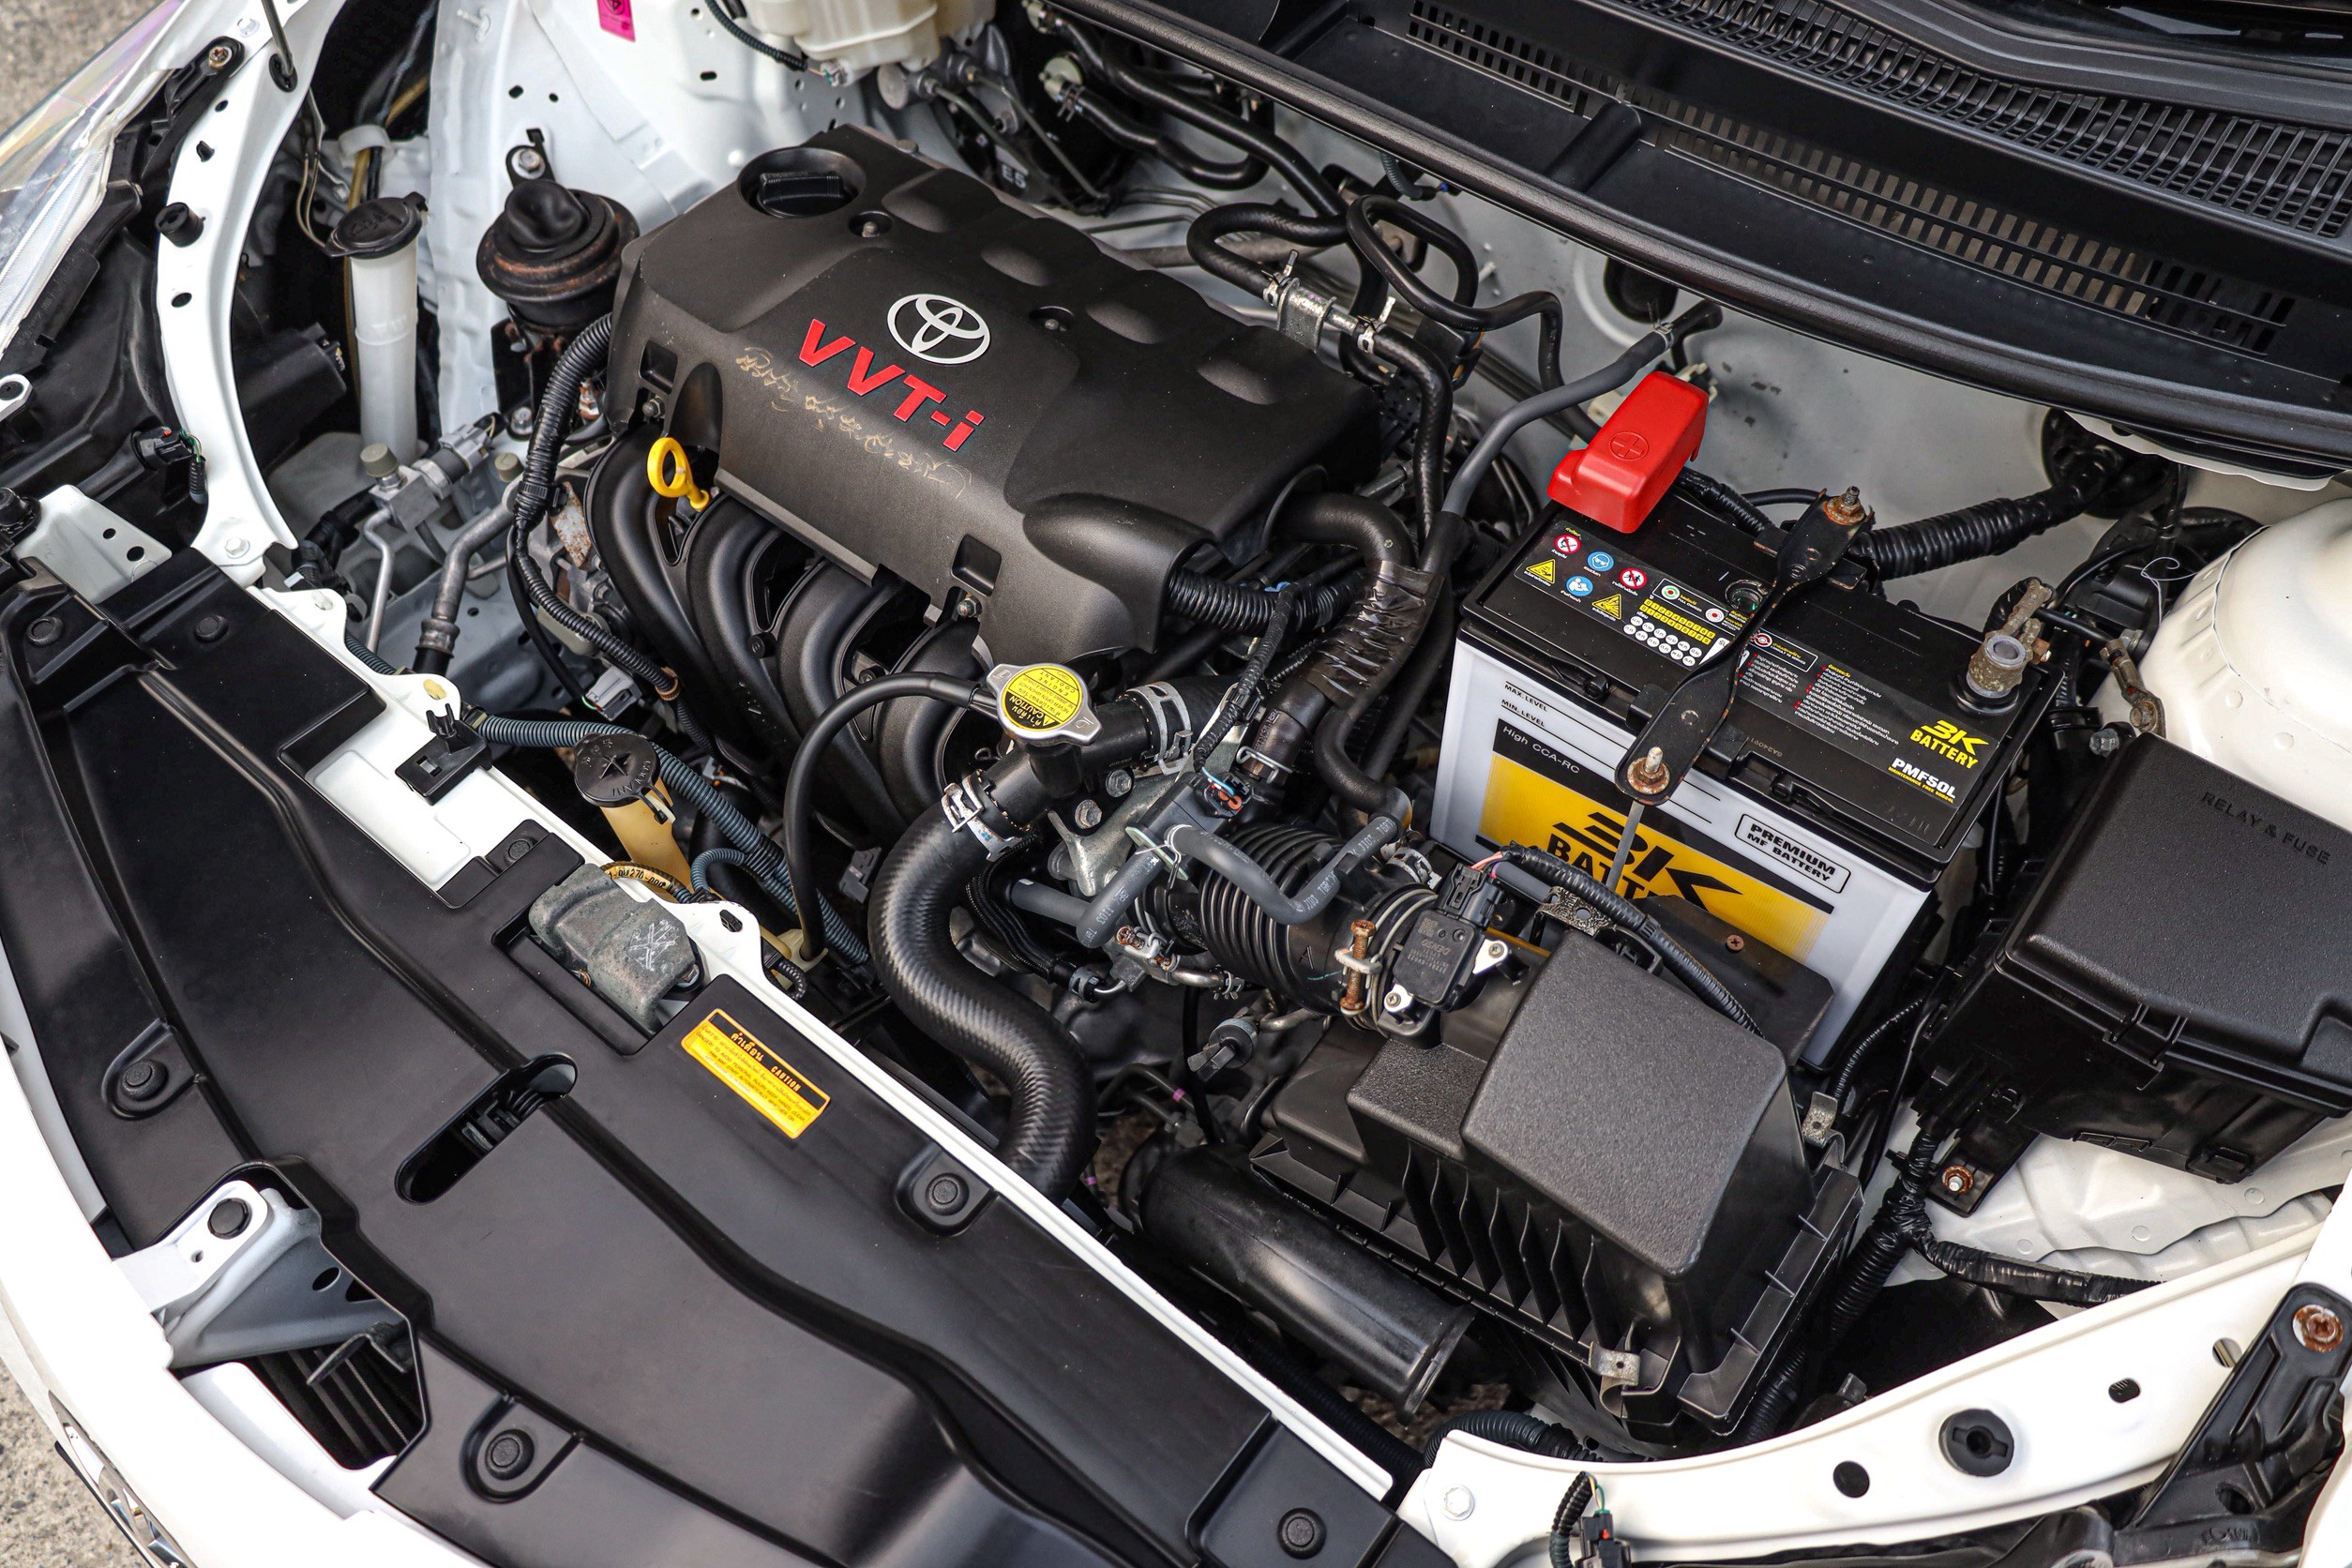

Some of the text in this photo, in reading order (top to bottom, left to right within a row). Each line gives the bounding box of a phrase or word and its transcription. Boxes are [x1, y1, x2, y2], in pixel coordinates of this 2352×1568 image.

[799, 319, 985, 452] VVT-i
[1037, 676, 1069, 696] ENGINE
[1038, 671, 1076, 693] COOLANT
[1505, 685, 1547, 712] MAX. LEVEL
[1009, 695, 1045, 718] CAUTION
[1011, 705, 1041, 727] คำเตือน
[1053, 701, 1069, 713] NEVER
[1501, 700, 1545, 727] MIN. LEVEL
[1503, 727, 1580, 774] High CCA-RC
[1909, 730, 1978, 769] BATTERY
[1921, 719, 1989, 755] 3K
[1892, 758, 1956, 798] PMF50L
[2202, 792, 2330, 865] RELAY & FUSE
[1747, 833, 1831, 882] MF BATTERY
[1750, 823, 1835, 876] PREMIUM
[1421, 939, 1452, 955] DENSO
[731, 1032, 763, 1062] คำเตือน
[771, 1065, 801, 1092] CAUTION
